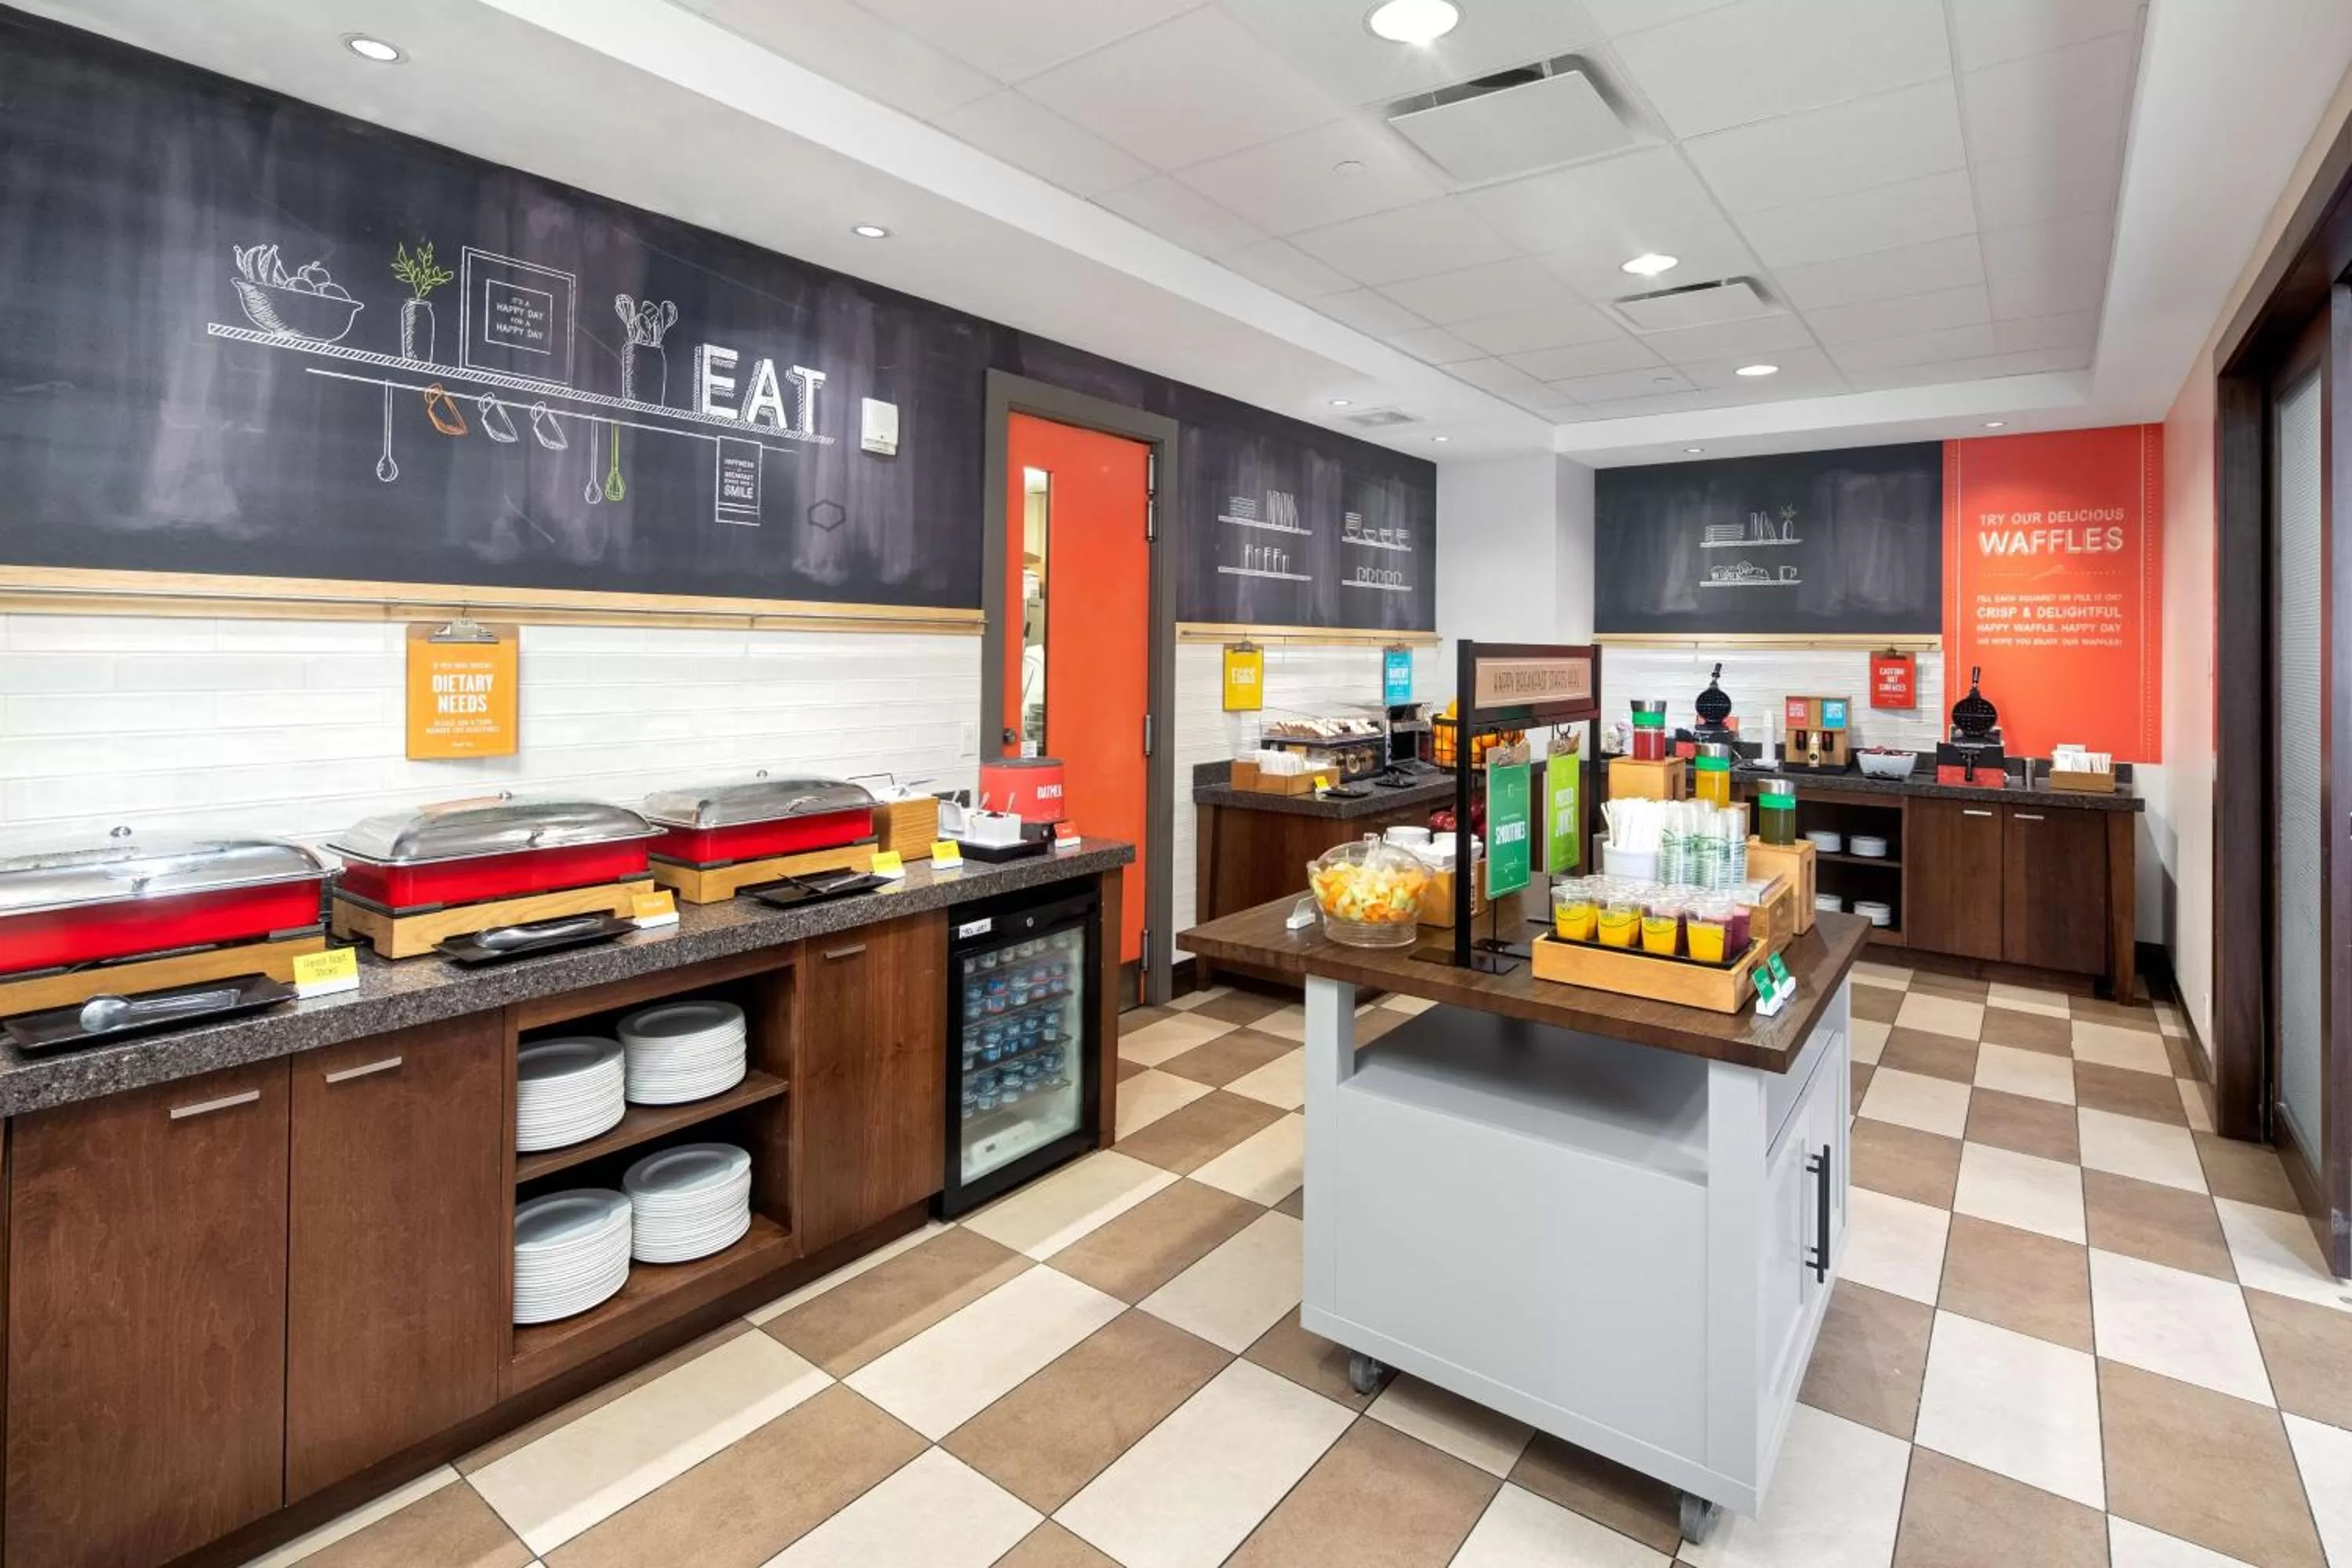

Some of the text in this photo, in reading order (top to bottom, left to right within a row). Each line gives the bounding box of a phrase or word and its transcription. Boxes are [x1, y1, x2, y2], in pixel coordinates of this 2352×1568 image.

[496, 303, 544, 321] HAPPY DAY
[496, 322, 543, 340] HAPPY DAY
[693, 343, 827, 434] EAT
[724, 485, 753, 499] SMILE
[1980, 508, 2125, 526] TRY OUR DELICIOUS
[1978, 527, 2124, 557] WAFFLES
[1977, 607, 2122, 619] CRISP & DELIGHTFUL
[1977, 623, 2009, 633] HAPPY
[2061, 623, 2096, 633] HAPPY
[2100, 623, 2122, 633] DAY
[432, 674, 495, 693] DIETARY
[437, 695, 488, 713] NEEDS
